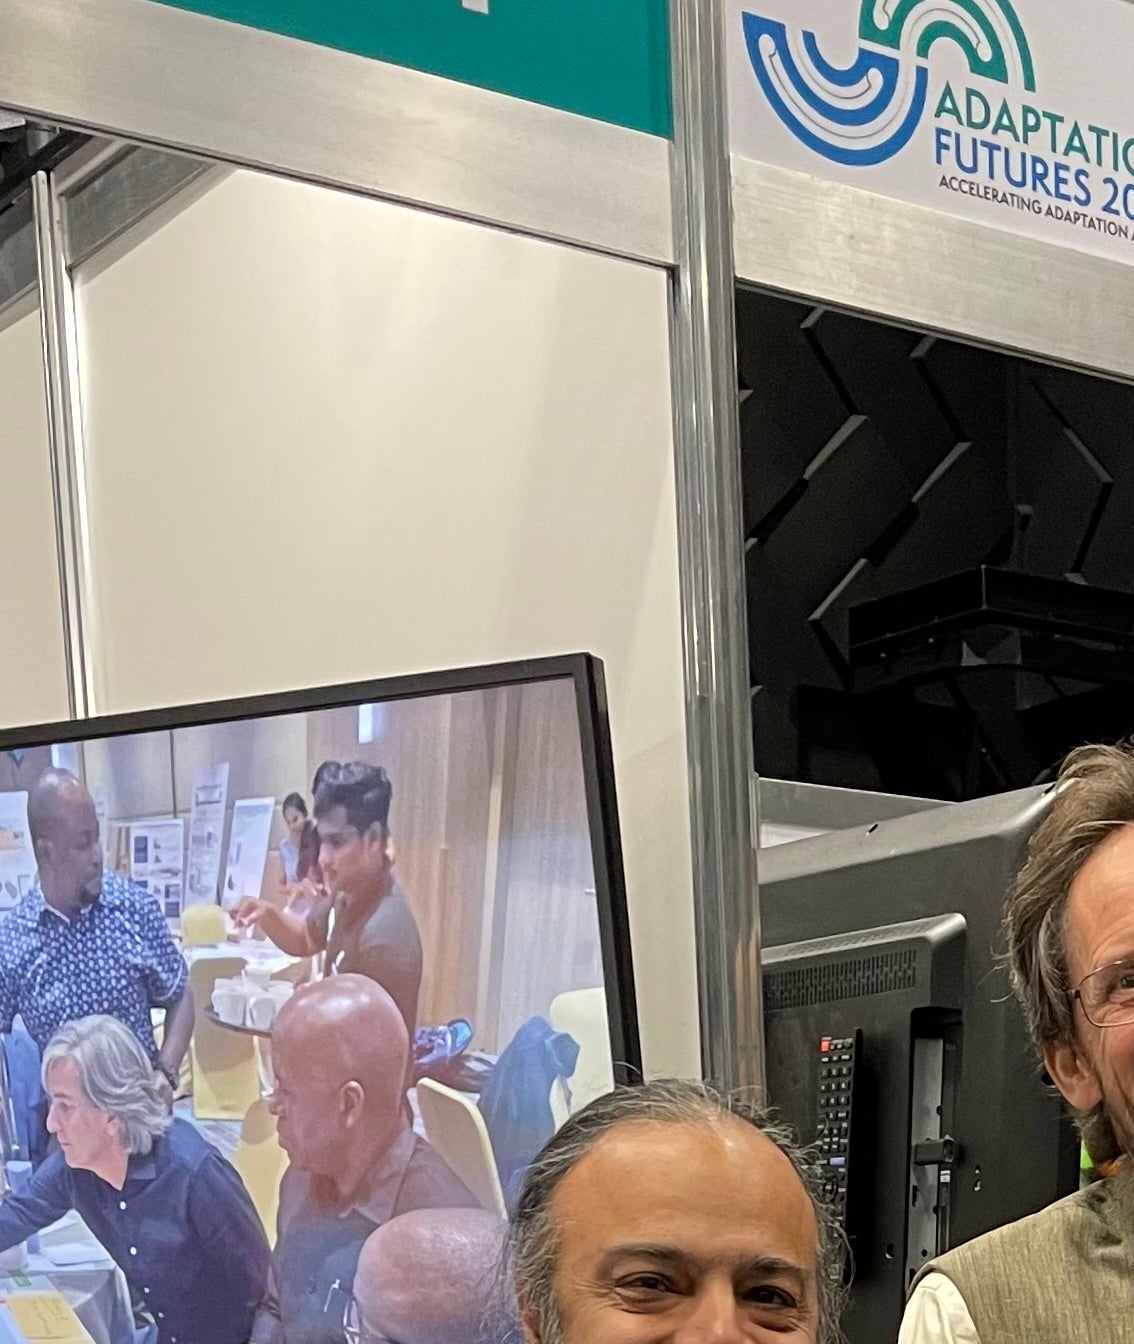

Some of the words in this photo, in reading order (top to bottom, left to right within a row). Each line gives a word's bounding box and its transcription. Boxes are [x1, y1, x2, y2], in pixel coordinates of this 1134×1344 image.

[935, 127, 1091, 207] FUTURES
[938, 174, 1043, 215] ACCELERATING
[1044, 204, 1129, 240] ADAPTATION
